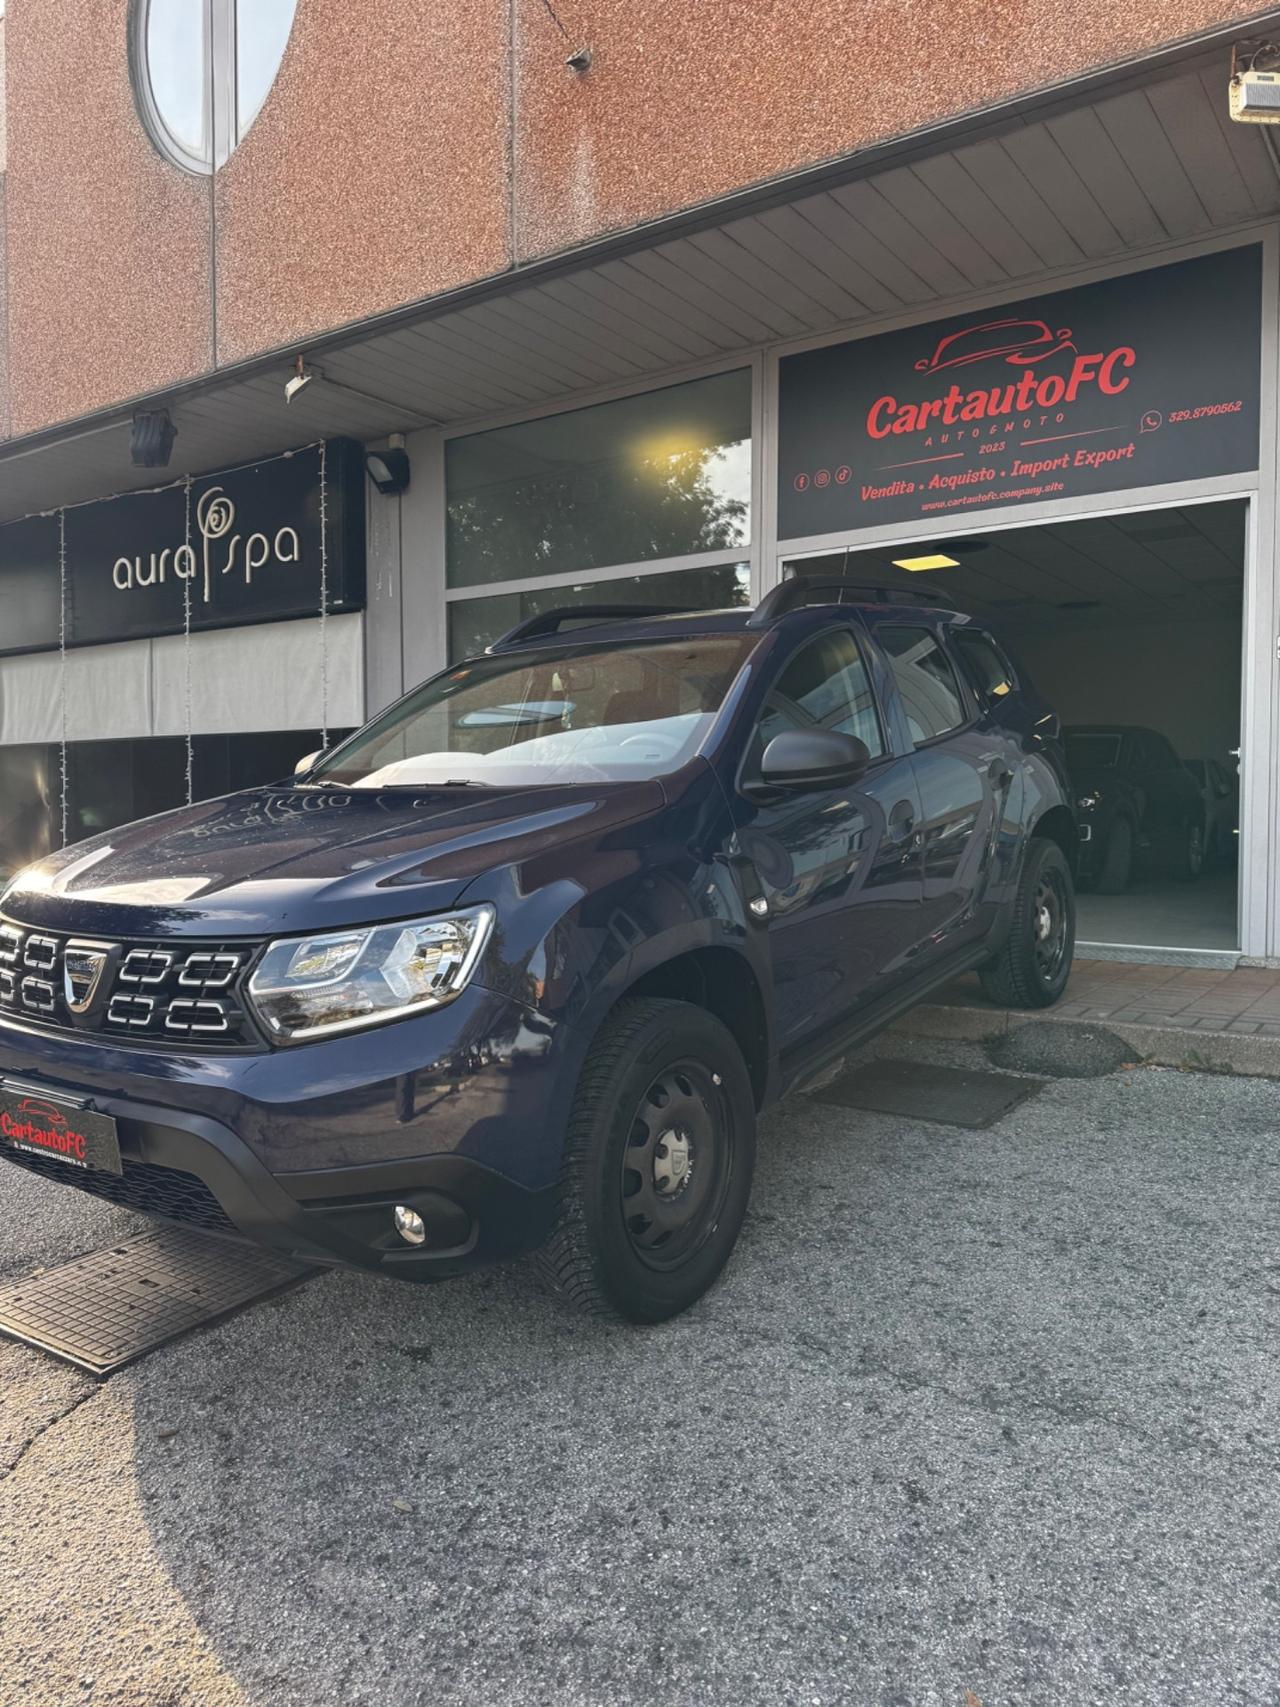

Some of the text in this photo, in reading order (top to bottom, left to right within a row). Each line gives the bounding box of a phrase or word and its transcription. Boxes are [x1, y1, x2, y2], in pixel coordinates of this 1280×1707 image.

[865, 346, 1136, 440] CartautoFC
[1168, 400, 1242, 423] 329.8790562
[860, 442, 1136, 502] Vendita Acquisto Import Export
[978, 441, 1006, 455] 2023
[920, 482, 1064, 512] www.cartautofc.company.site
[112, 526, 299, 590] aura spa
[0, 1111, 87, 1160] CartautoFC
